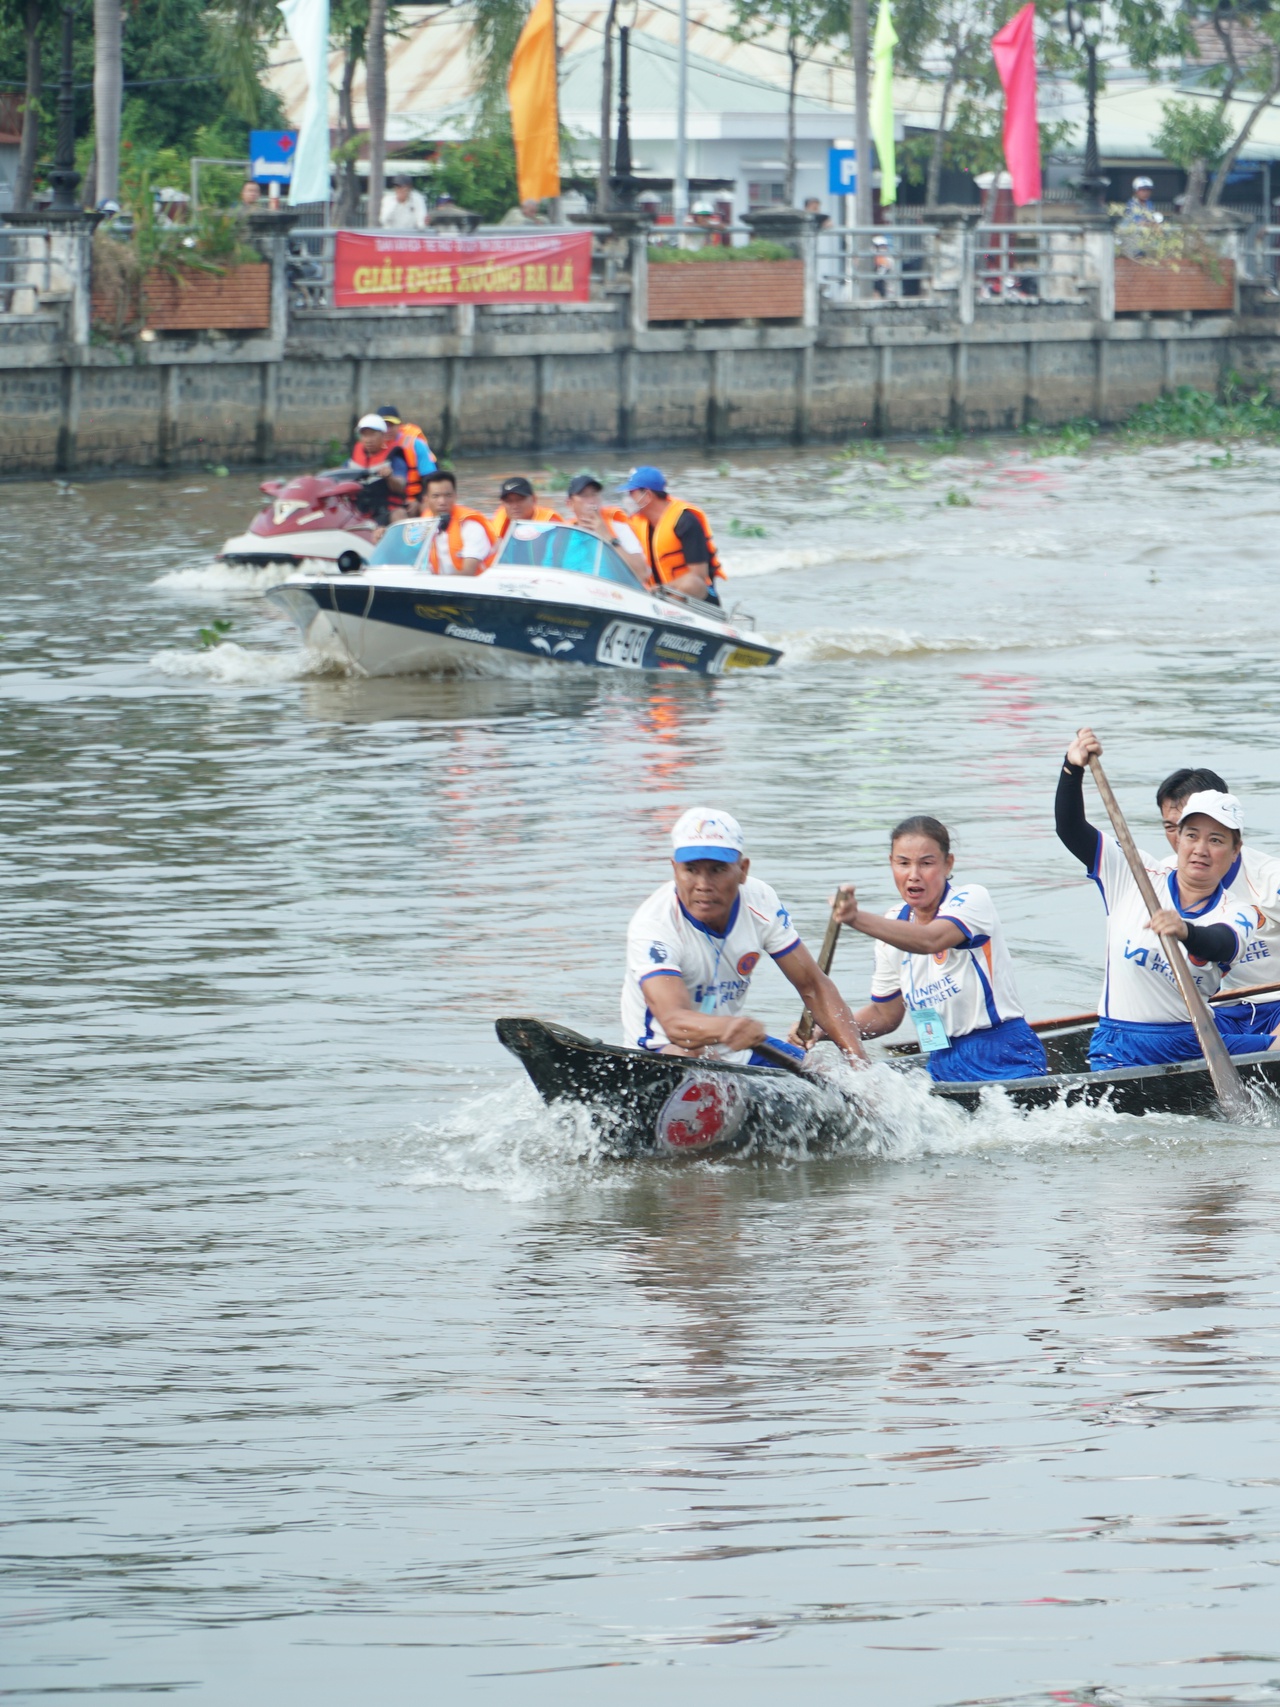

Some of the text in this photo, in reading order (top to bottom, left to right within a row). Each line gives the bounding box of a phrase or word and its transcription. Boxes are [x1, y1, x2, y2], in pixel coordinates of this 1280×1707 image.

[840, 159, 858, 186] P
[353, 256, 403, 294] GIẢI
[406, 265, 452, 293] ĐUA
[525, 264, 548, 292] BA
[551, 257, 574, 292] LÁ
[667, 1082, 725, 1148] 3
